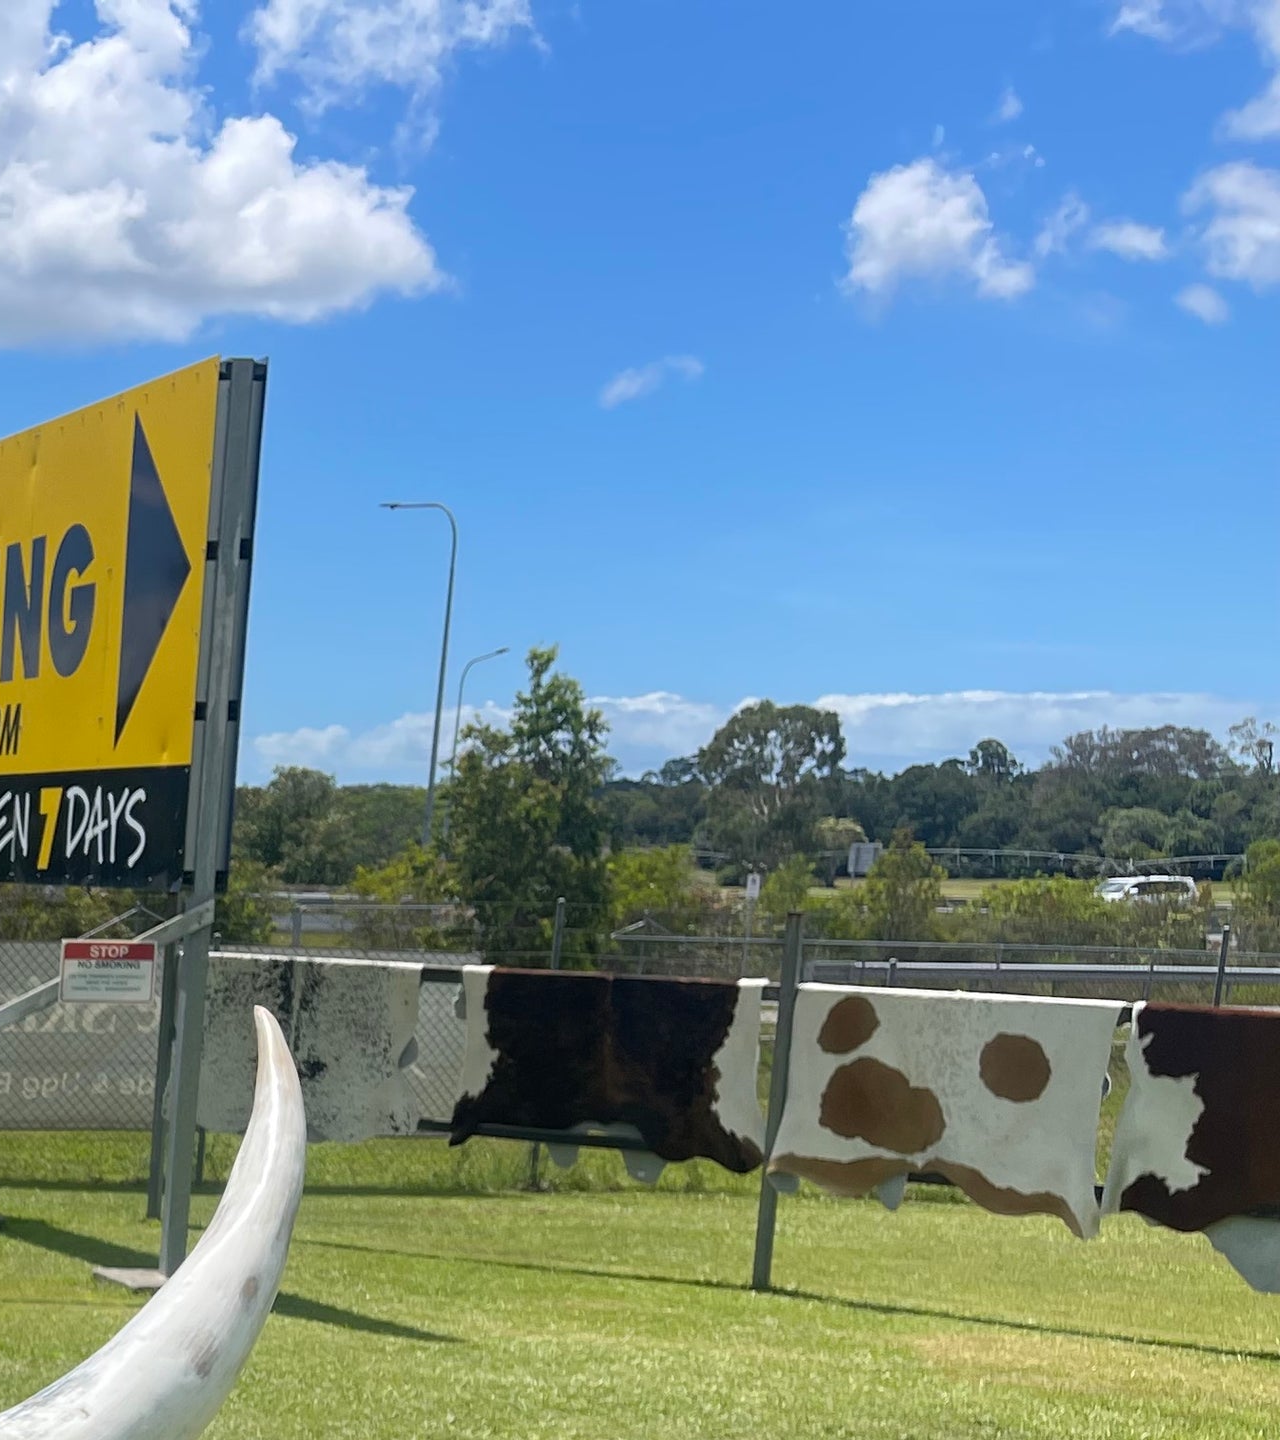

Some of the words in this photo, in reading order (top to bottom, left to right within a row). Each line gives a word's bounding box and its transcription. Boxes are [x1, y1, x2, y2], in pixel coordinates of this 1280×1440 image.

[37, 786, 63, 871] 7
[66, 785, 147, 868] DAYS
[89, 944, 129, 958] STOP
[77, 959, 93, 969] NO
